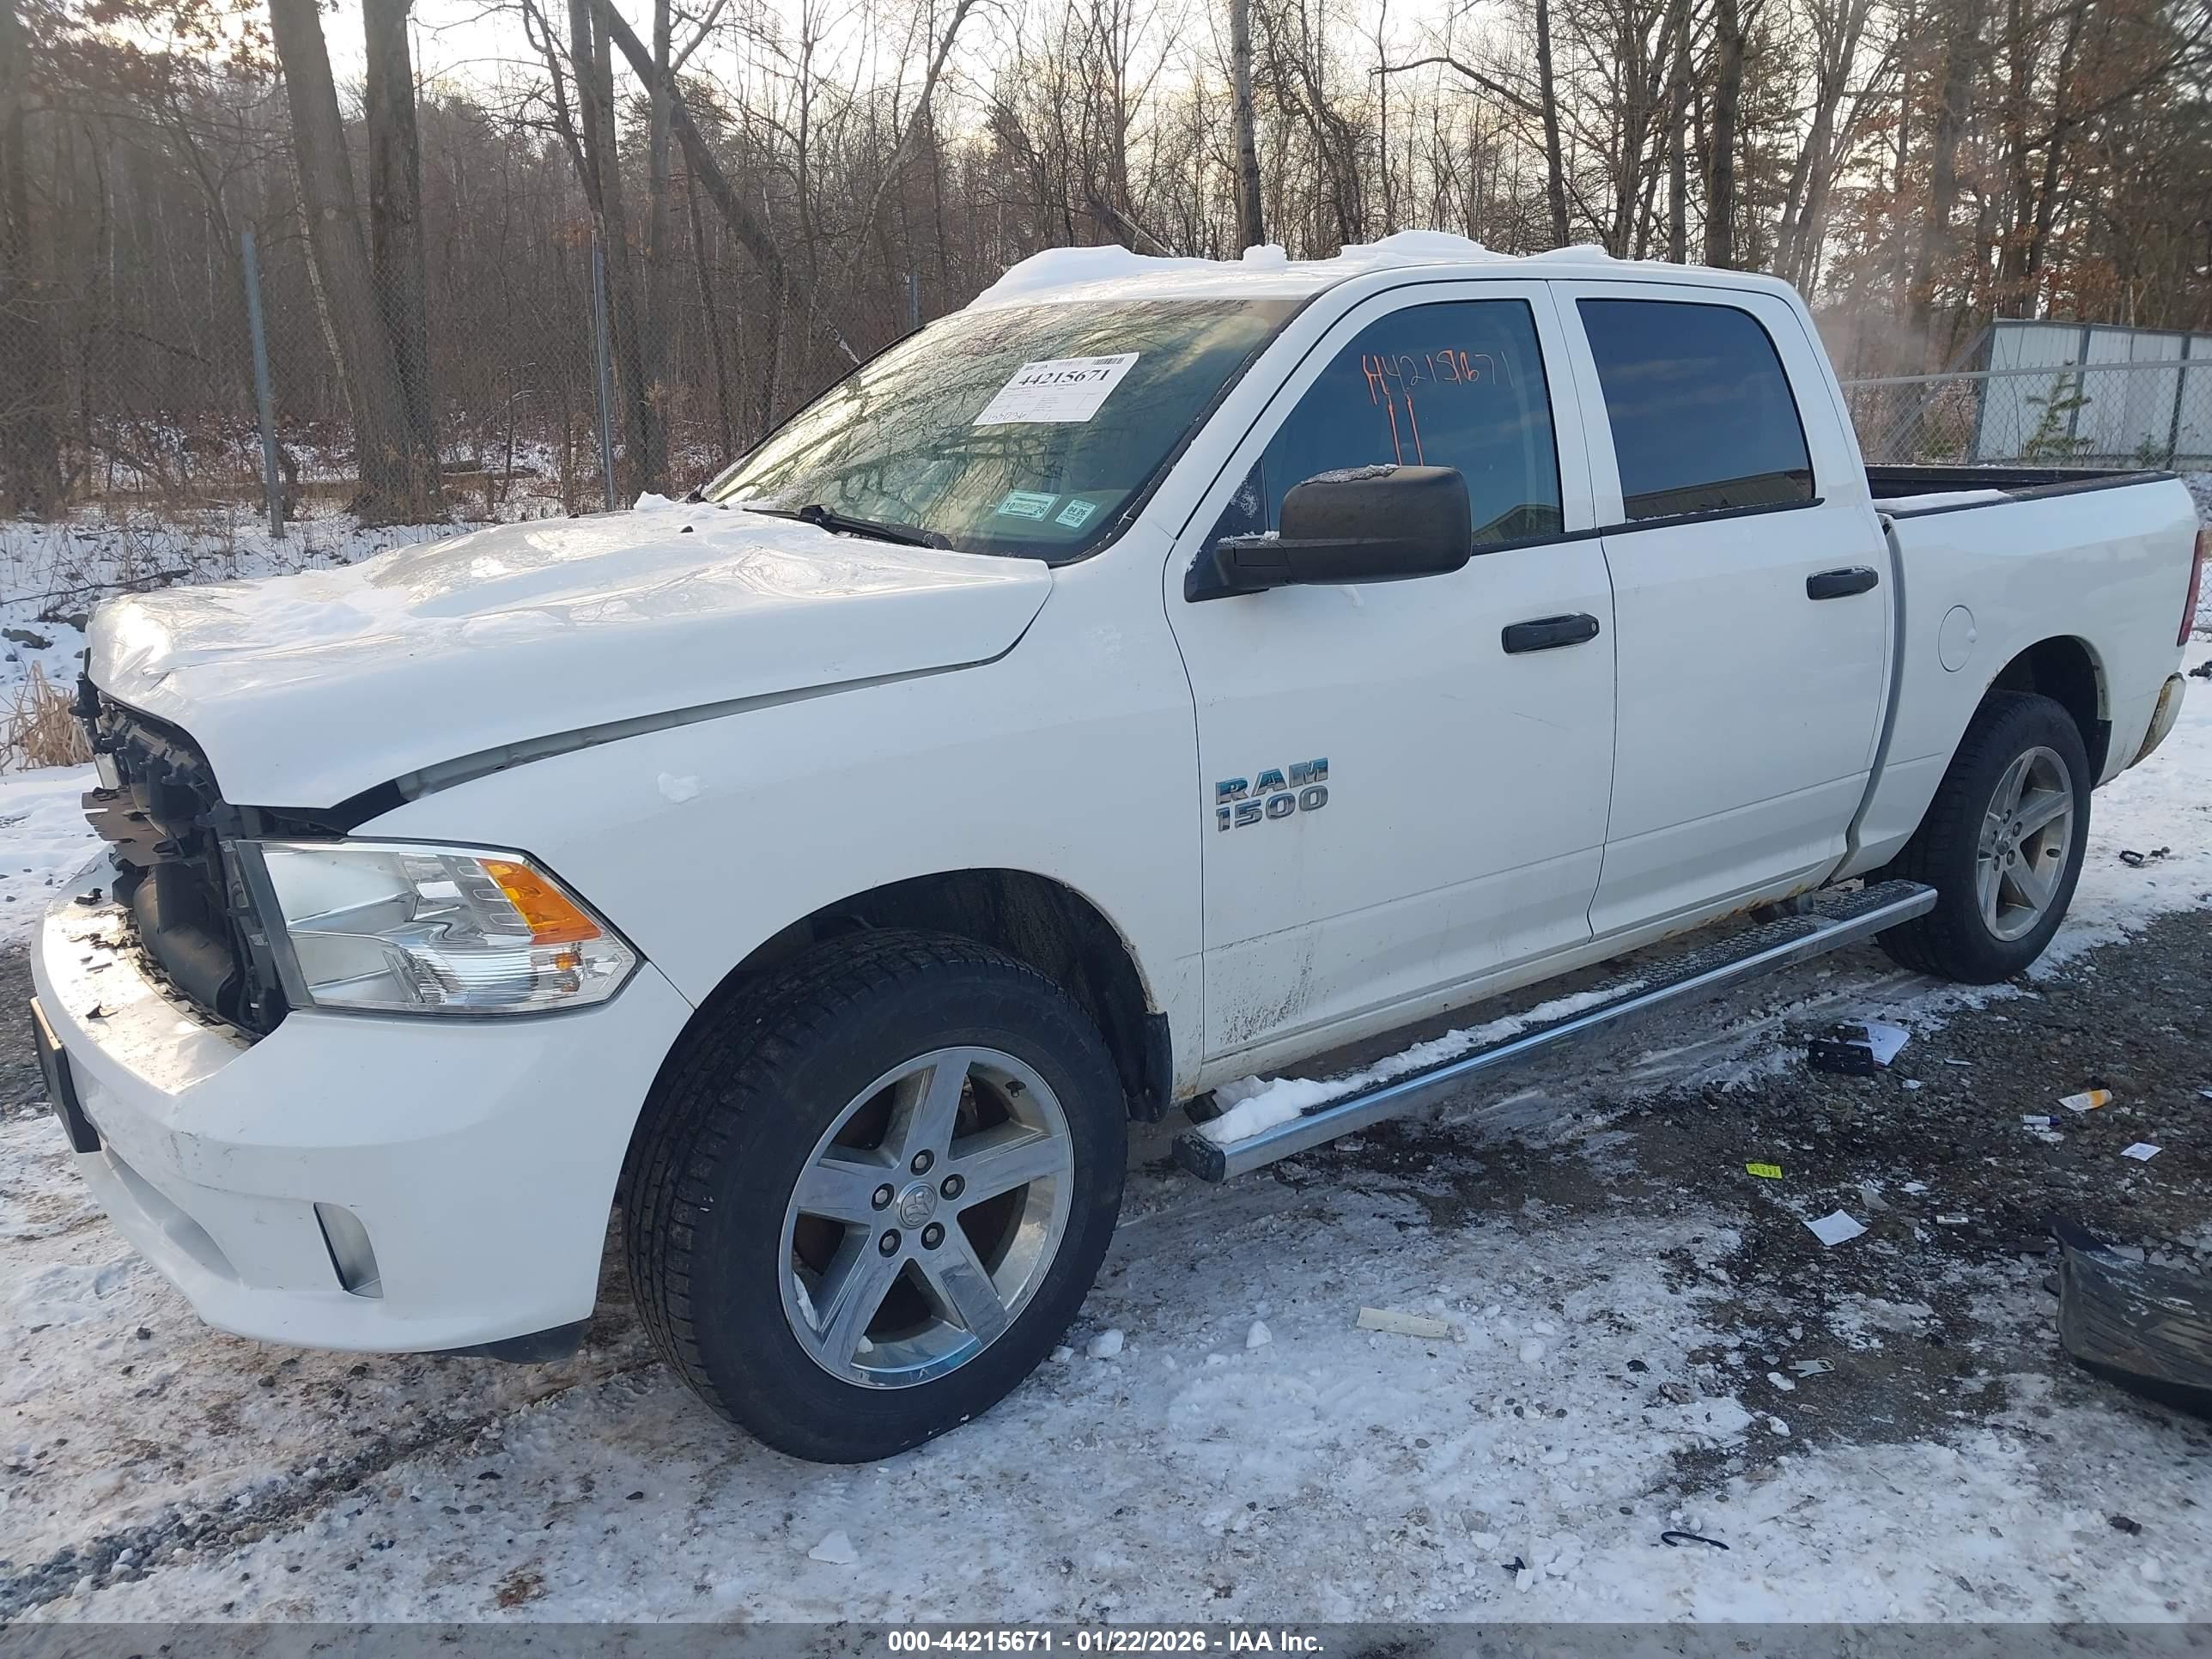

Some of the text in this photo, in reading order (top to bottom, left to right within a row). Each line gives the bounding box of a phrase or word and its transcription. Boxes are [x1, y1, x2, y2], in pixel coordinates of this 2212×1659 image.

[1018, 369, 1110, 386] 44215671
[1215, 757, 1329, 805] RAM
[1215, 785, 1329, 832] 1500
